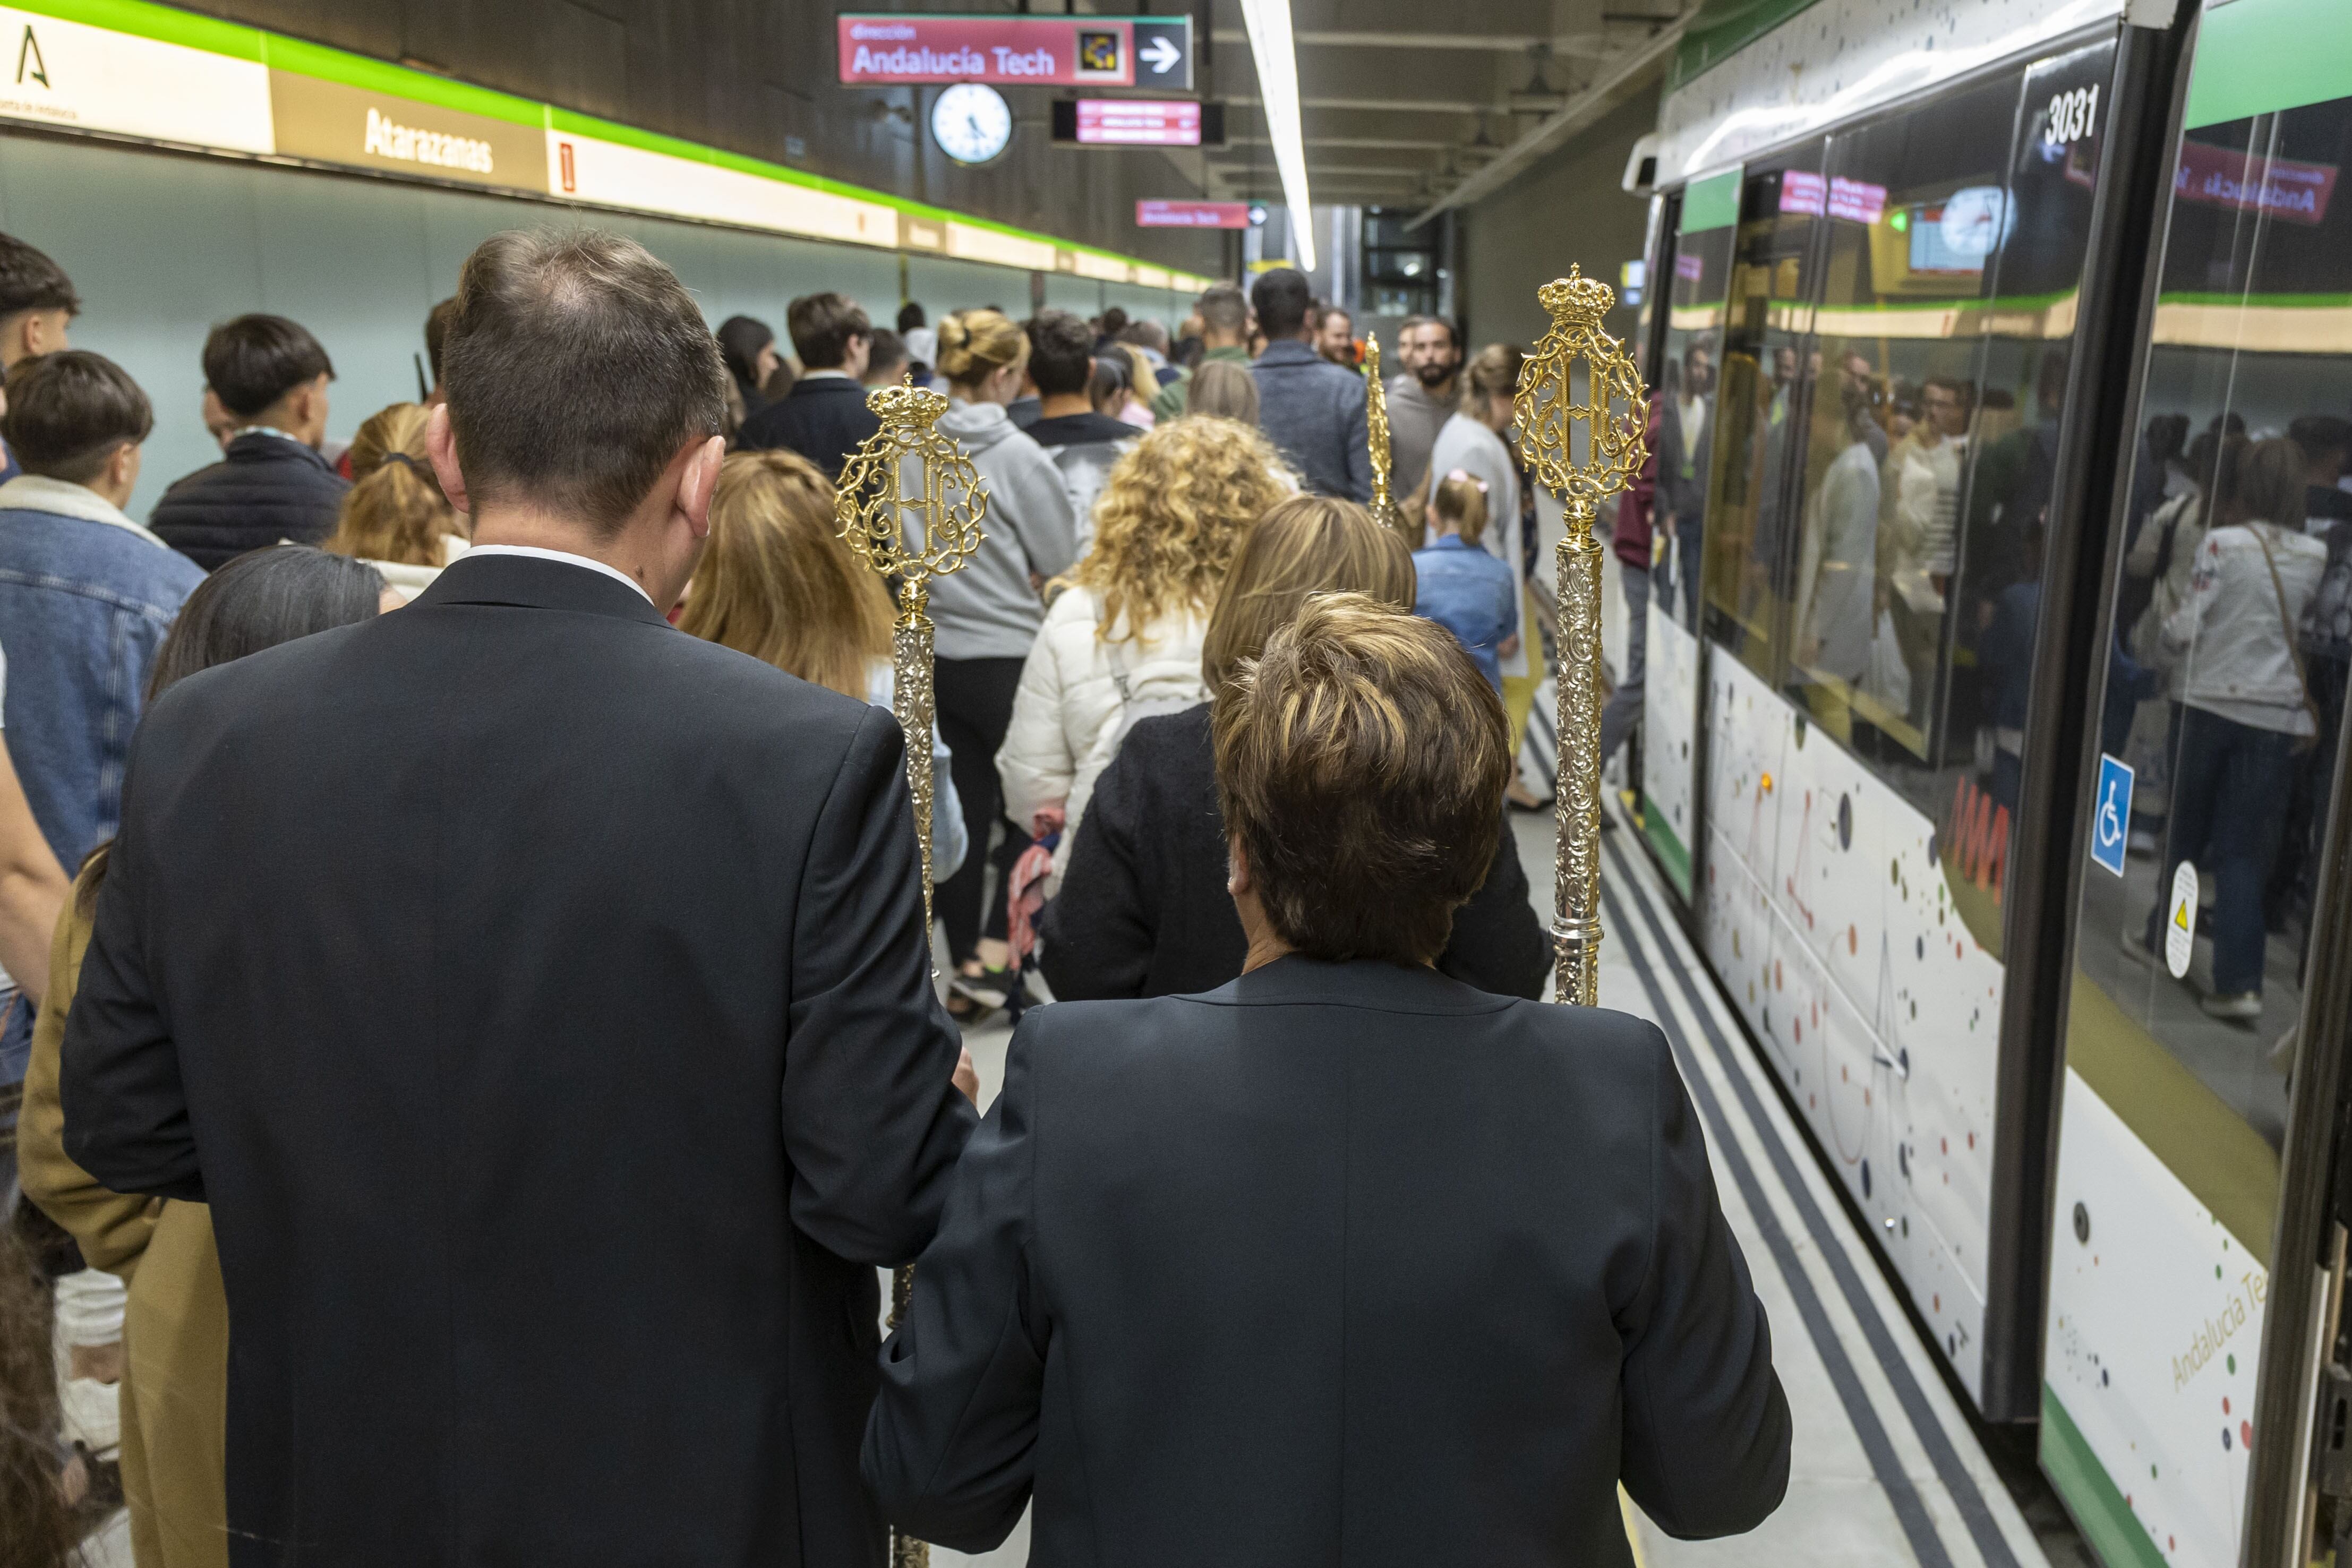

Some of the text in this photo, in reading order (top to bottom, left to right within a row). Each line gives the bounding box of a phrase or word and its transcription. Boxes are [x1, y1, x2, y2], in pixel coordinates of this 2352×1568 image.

[852, 45, 1055, 75] Andalucía Tech
[364, 107, 493, 174] Atarazanas
[2045, 82, 2100, 146] 3031
[2172, 1292, 2246, 1394] Andalucía
